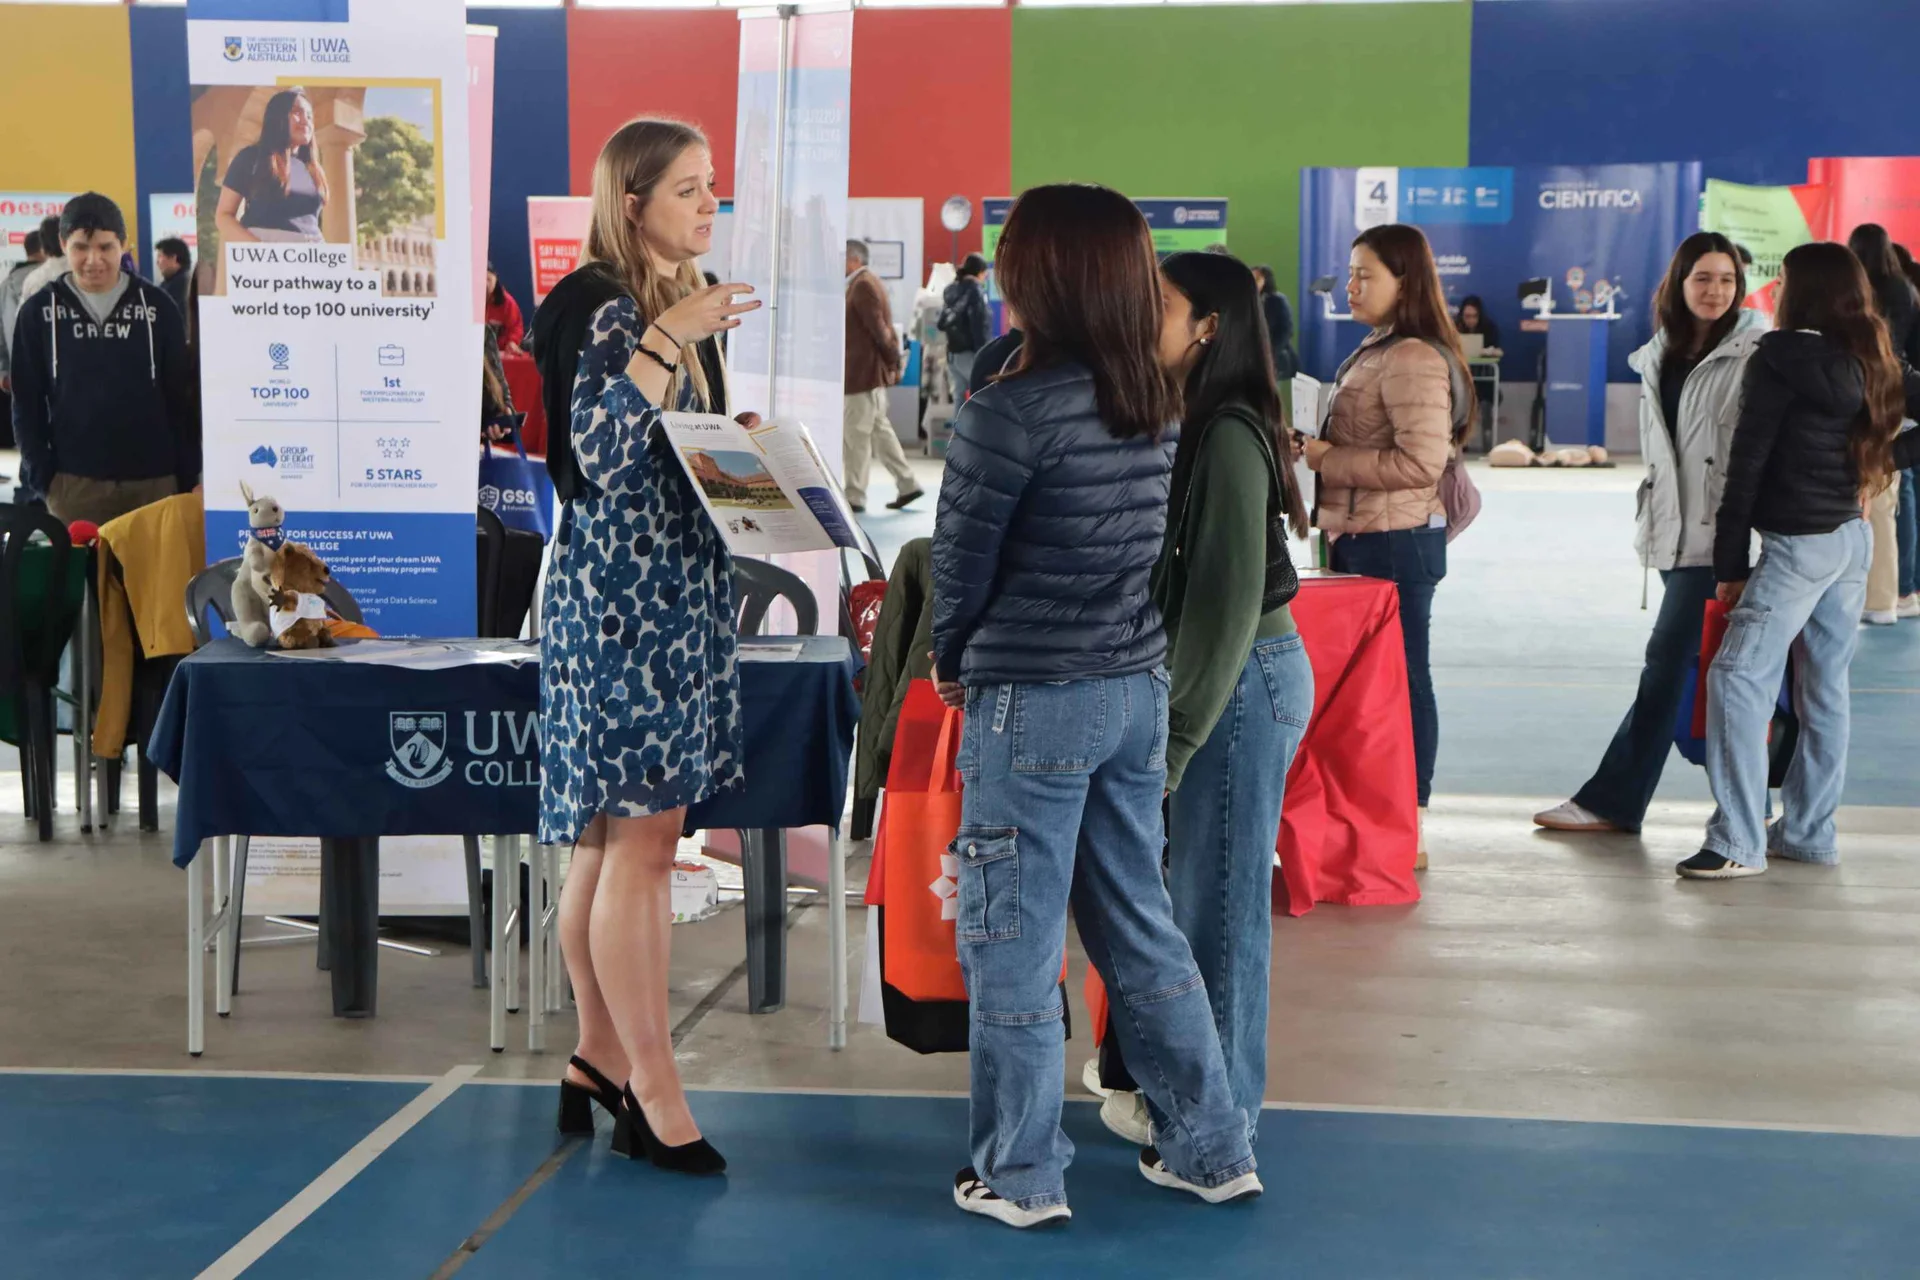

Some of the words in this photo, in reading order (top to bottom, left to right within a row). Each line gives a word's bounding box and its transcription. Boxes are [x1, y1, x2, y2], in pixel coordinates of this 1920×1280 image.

[246, 42, 297, 52] WESTERN
[310, 38, 350, 53] UWA
[247, 52, 297, 62] AUSTRALIA
[311, 53, 351, 63] COLLEGE
[1370, 181, 1387, 204] 4
[231, 248, 279, 263] UWA
[283, 248, 347, 268] College
[232, 275, 269, 290] Your
[274, 276, 342, 293] pathway
[347, 277, 364, 290] to
[368, 280, 377, 290] a
[232, 302, 278, 316] world
[283, 303, 311, 319] top
[315, 302, 346, 316] 100
[73, 323, 131, 339] CREW
[384, 376, 401, 388] 1st
[250, 387, 280, 399] TOP
[284, 387, 310, 399] 100
[670, 421, 694, 431] Living
[702, 423, 723, 431] UWA
[280, 446, 308, 455] GROUP
[280, 455, 290, 463] OF
[291, 455, 315, 463] EIGHT
[366, 469, 374, 480] 5
[377, 469, 423, 481] STARS
[502, 489, 536, 505] GSG
[286, 530, 307, 539] FOR
[309, 530, 354, 540] SUCCESS
[355, 531, 368, 540] AT
[369, 531, 394, 540] UWA
[322, 555, 350, 563] second
[350, 557, 367, 565] year
[368, 555, 377, 563] of
[377, 557, 394, 565] your
[395, 556, 420, 564] dream
[420, 556, 441, 564] UWA
[331, 565, 367, 574] College's
[367, 565, 400, 575] pathway
[400, 566, 438, 575] programs:
[374, 596, 389, 604] and
[389, 596, 408, 605] Data
[408, 596, 438, 605] Science
[464, 711, 540, 756] UW
[465, 760, 540, 786] COLL
